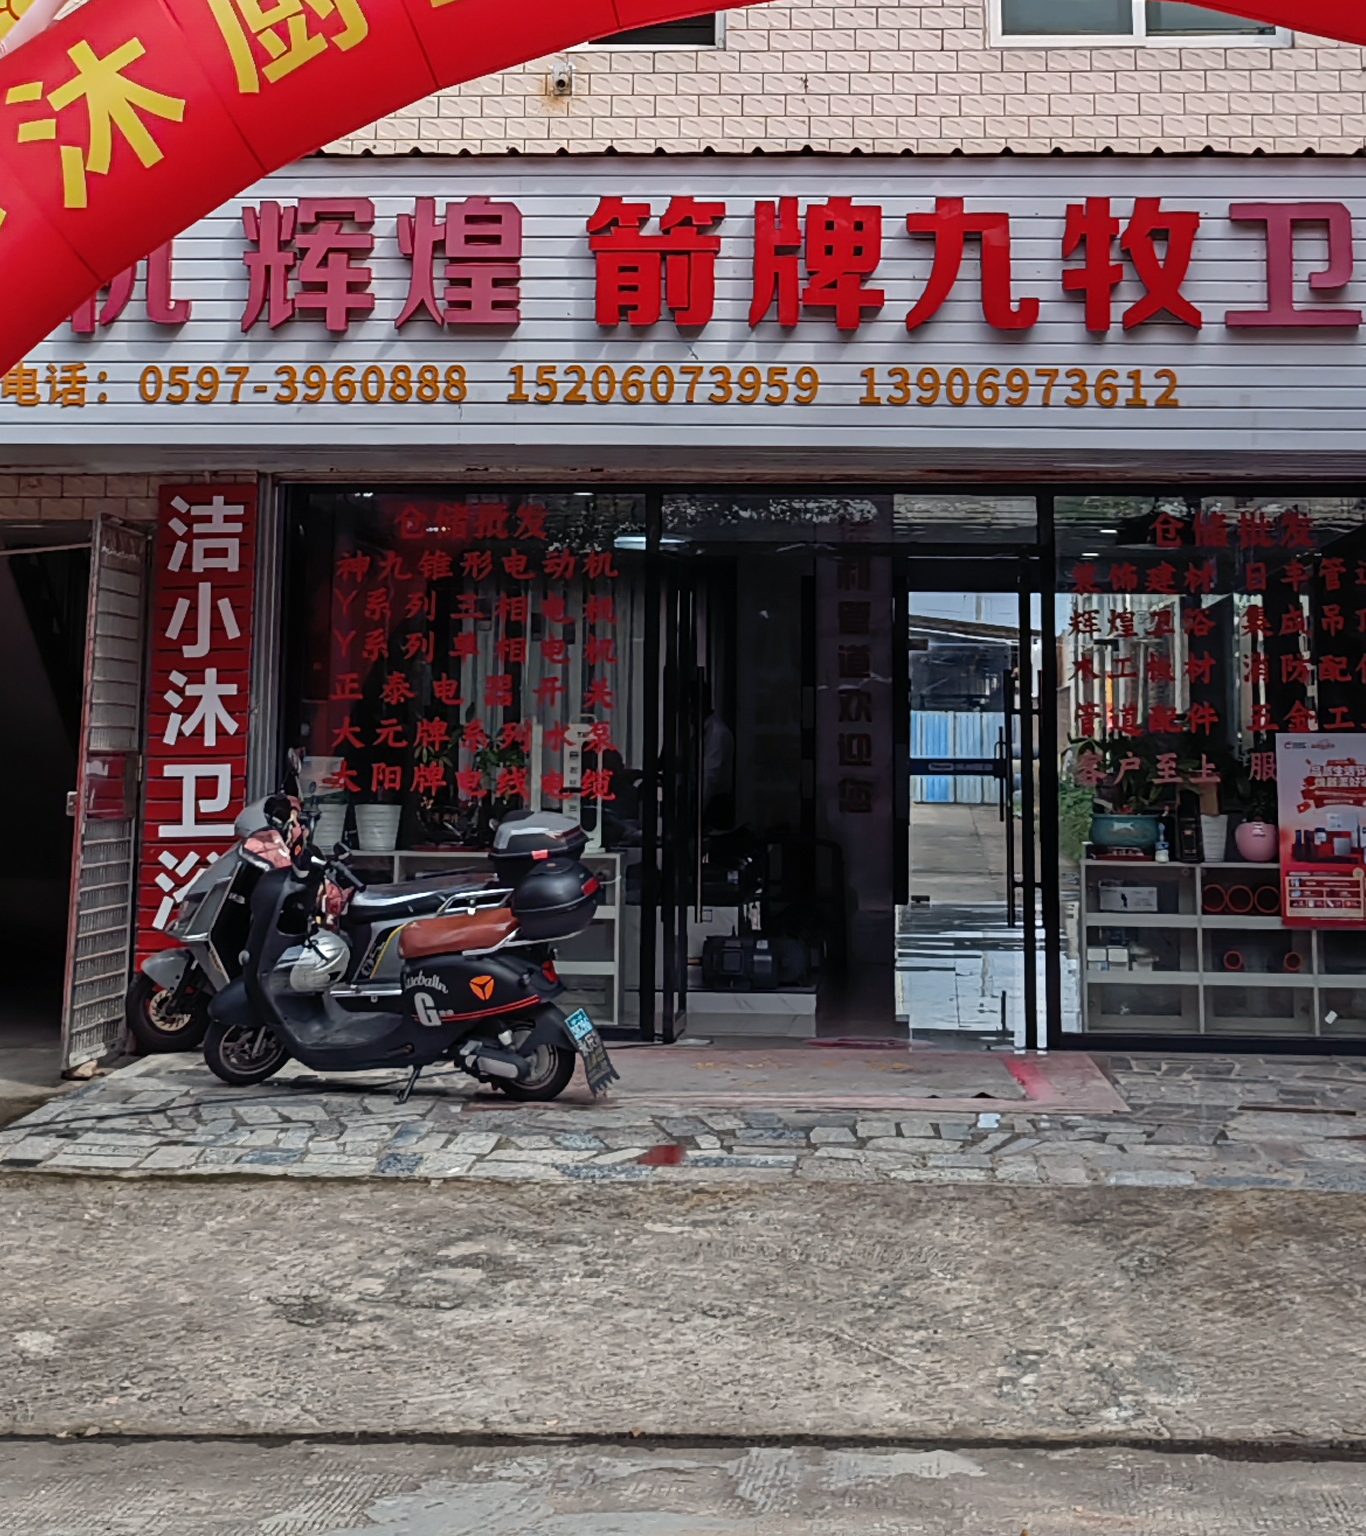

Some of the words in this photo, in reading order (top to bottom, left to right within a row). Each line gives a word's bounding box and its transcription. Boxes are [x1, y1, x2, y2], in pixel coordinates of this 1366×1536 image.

[240, 196, 523, 334] 辉煌
[138, 364, 468, 404] 0597-3960888
[506, 364, 821, 405] 15206073959
[859, 365, 1180, 407] 13906973612
[395, 501, 550, 542] 仓储批发
[1148, 510, 1316, 549] 仓储批发
[1068, 609, 1217, 639] 辉煌卫浴
[329, 671, 617, 709] 正泰电器开关
